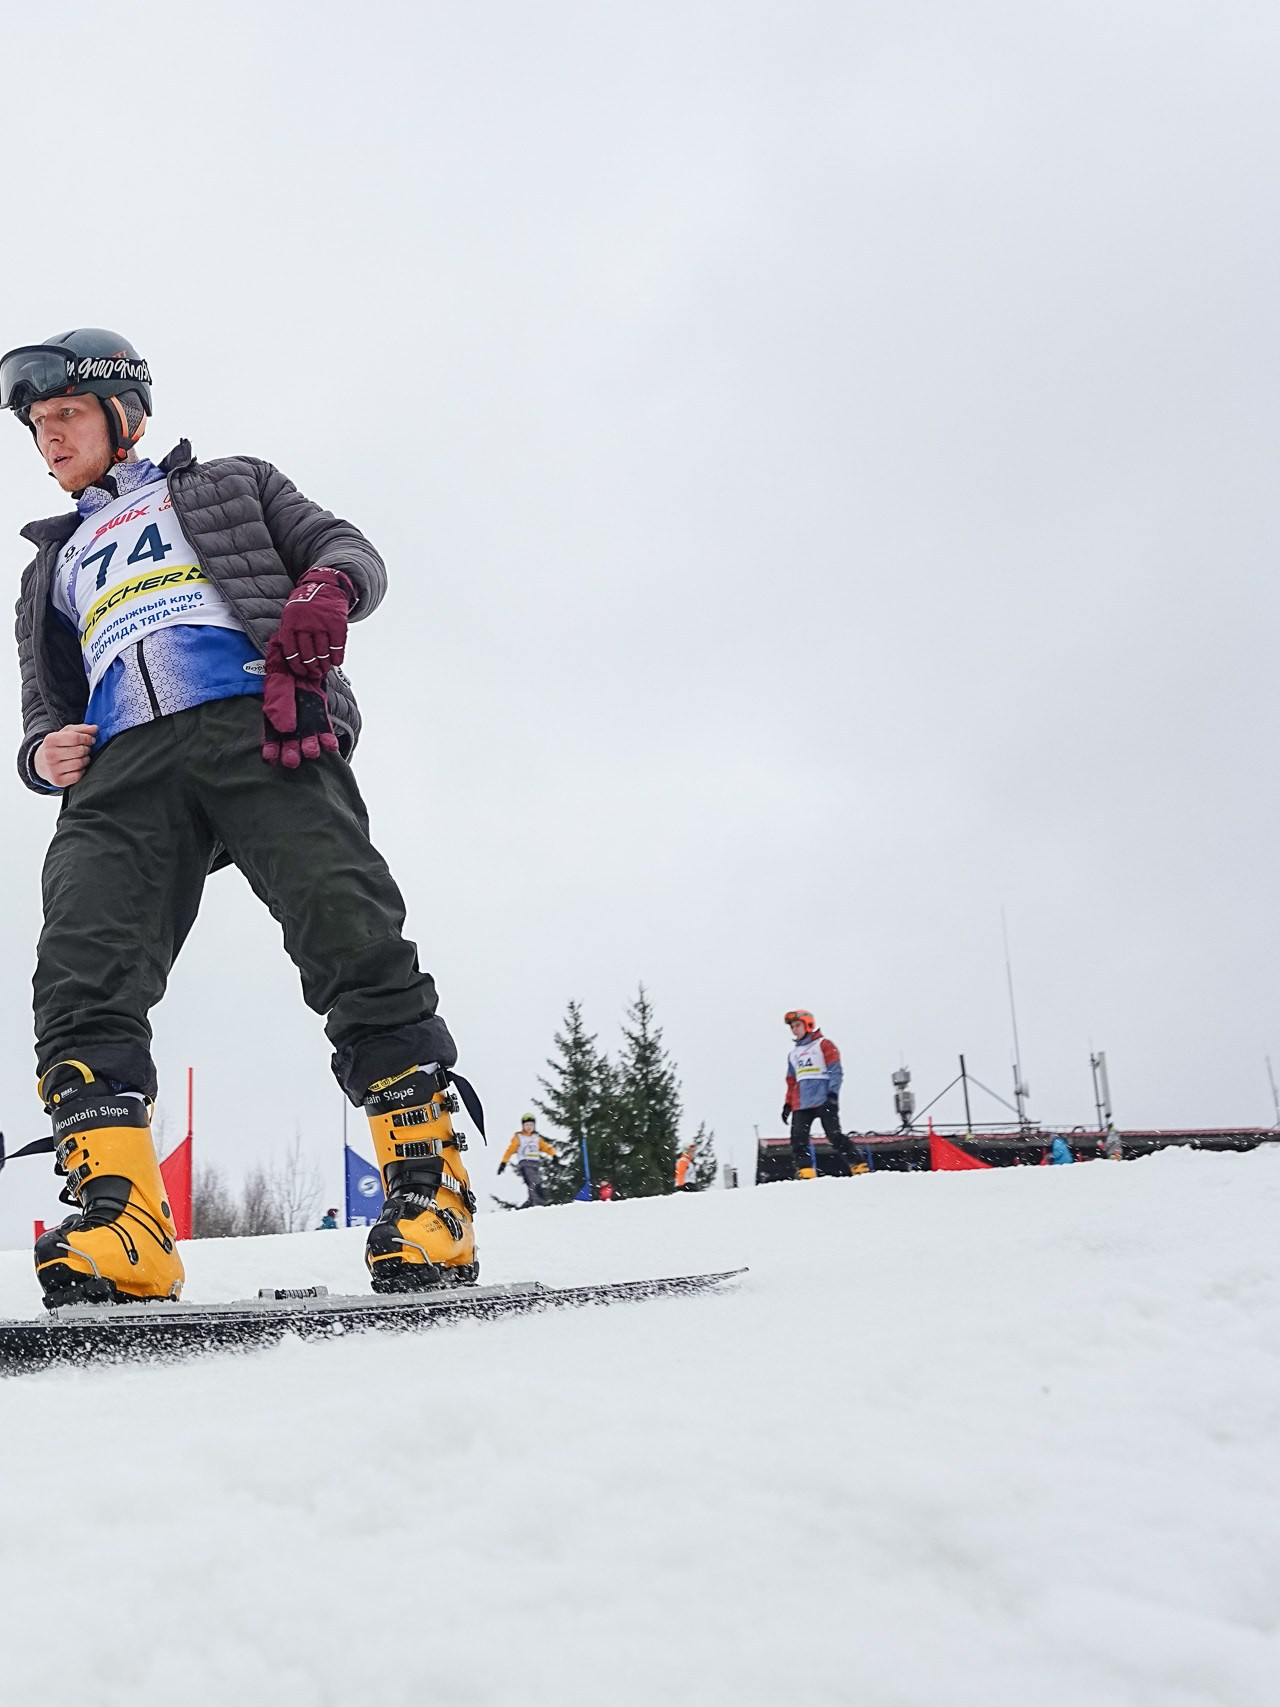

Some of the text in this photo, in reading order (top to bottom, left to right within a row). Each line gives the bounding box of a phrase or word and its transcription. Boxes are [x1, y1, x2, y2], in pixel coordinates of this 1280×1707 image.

[81, 523, 172, 591] 74
[169, 591, 203, 608] клуб
[92, 623, 138, 666] ЛЕОНИДА
[365, 1087, 414, 1105] tain Slope
[55, 1105, 129, 1133] Mountain Slope
